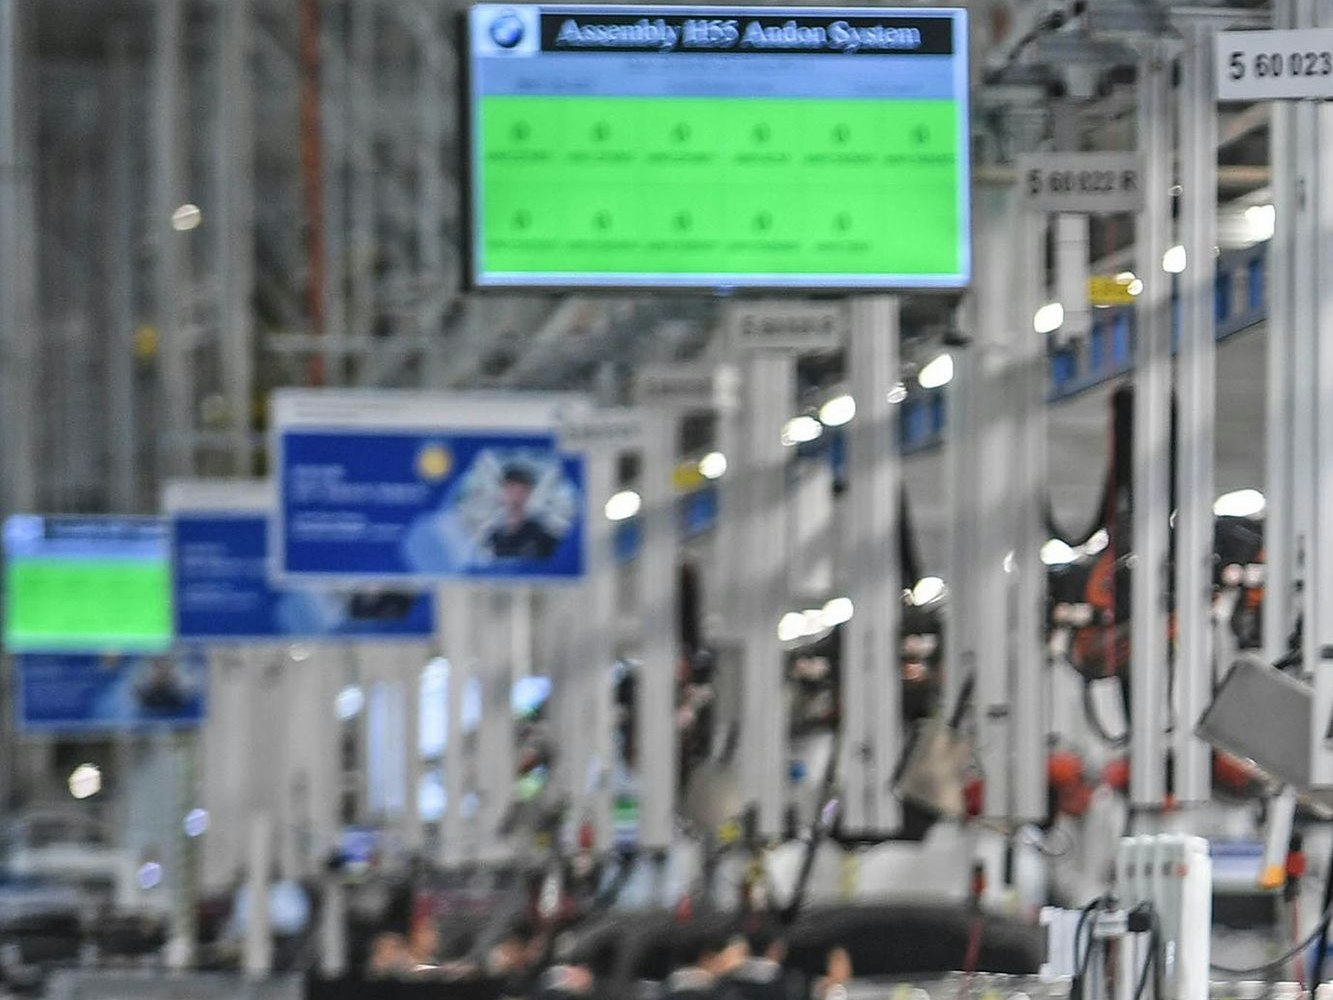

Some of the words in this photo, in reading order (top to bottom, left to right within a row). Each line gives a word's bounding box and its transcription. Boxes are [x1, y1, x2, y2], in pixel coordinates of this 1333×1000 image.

[556, 18, 681, 53] Assembly
[740, 20, 827, 48] Andon
[827, 20, 921, 54] System
[1254, 53, 1284, 78] 60
[1288, 52, 1333, 77] 023
[1121, 170, 1138, 192] R
